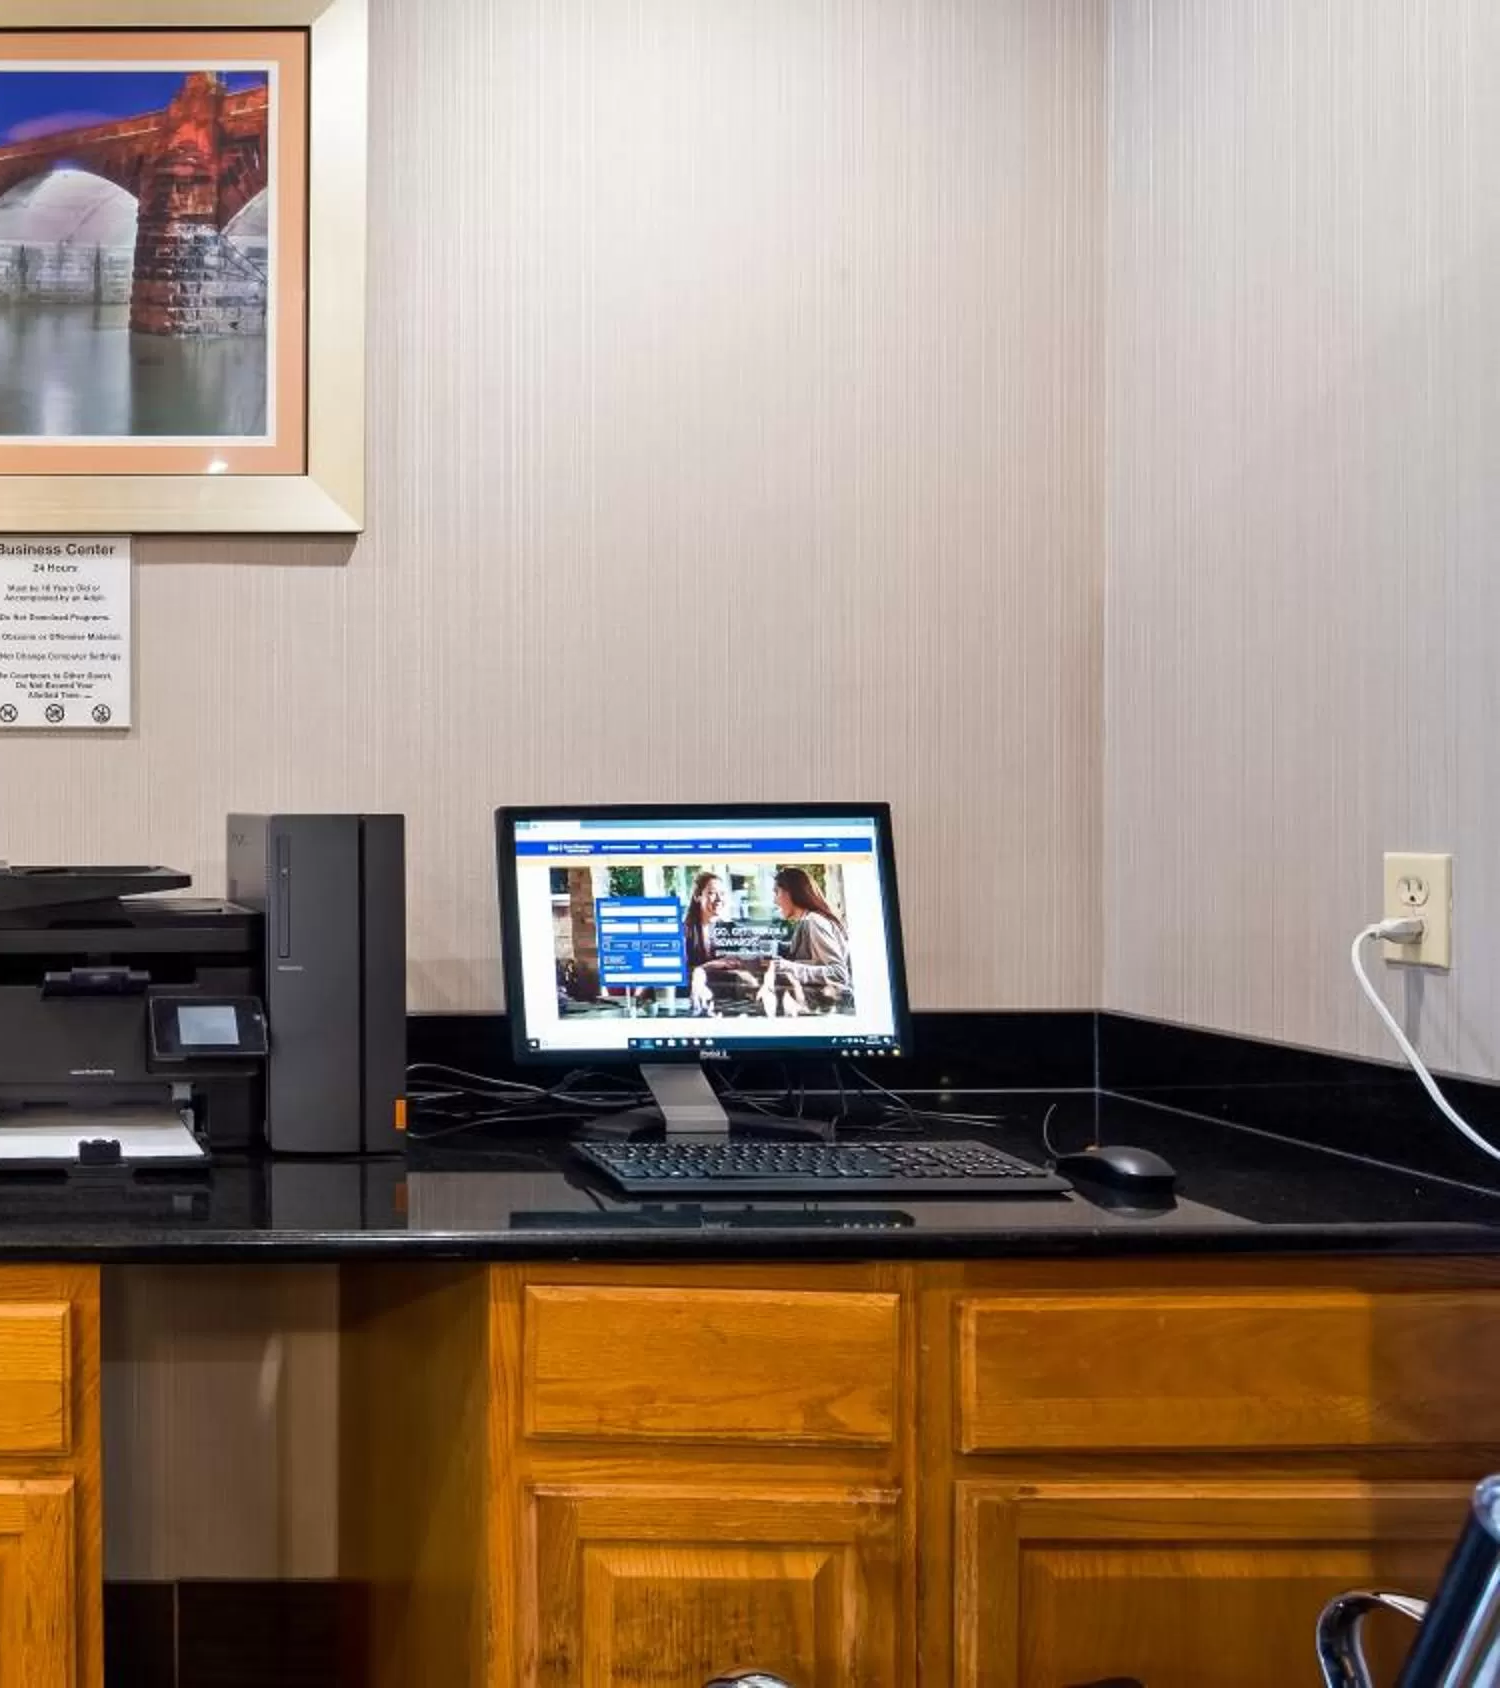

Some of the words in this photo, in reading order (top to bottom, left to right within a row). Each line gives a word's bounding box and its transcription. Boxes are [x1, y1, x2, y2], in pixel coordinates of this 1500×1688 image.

[65, 543, 116, 556] Center
[32, 563, 45, 573] 24
[47, 563, 78, 573] Hours
[52, 584, 74, 592] Years
[59, 594, 69, 603] by
[0, 613, 11, 621] Do
[13, 613, 27, 621] Not
[29, 613, 69, 621] Download
[1, 633, 37, 641] Obscene
[38, 633, 47, 641] or
[50, 633, 85, 641] Offensive
[0, 652, 14, 660] Not
[15, 652, 46, 661] Change
[47, 652, 87, 661] Computer
[52, 671, 61, 679] to
[63, 671, 85, 679] Other
